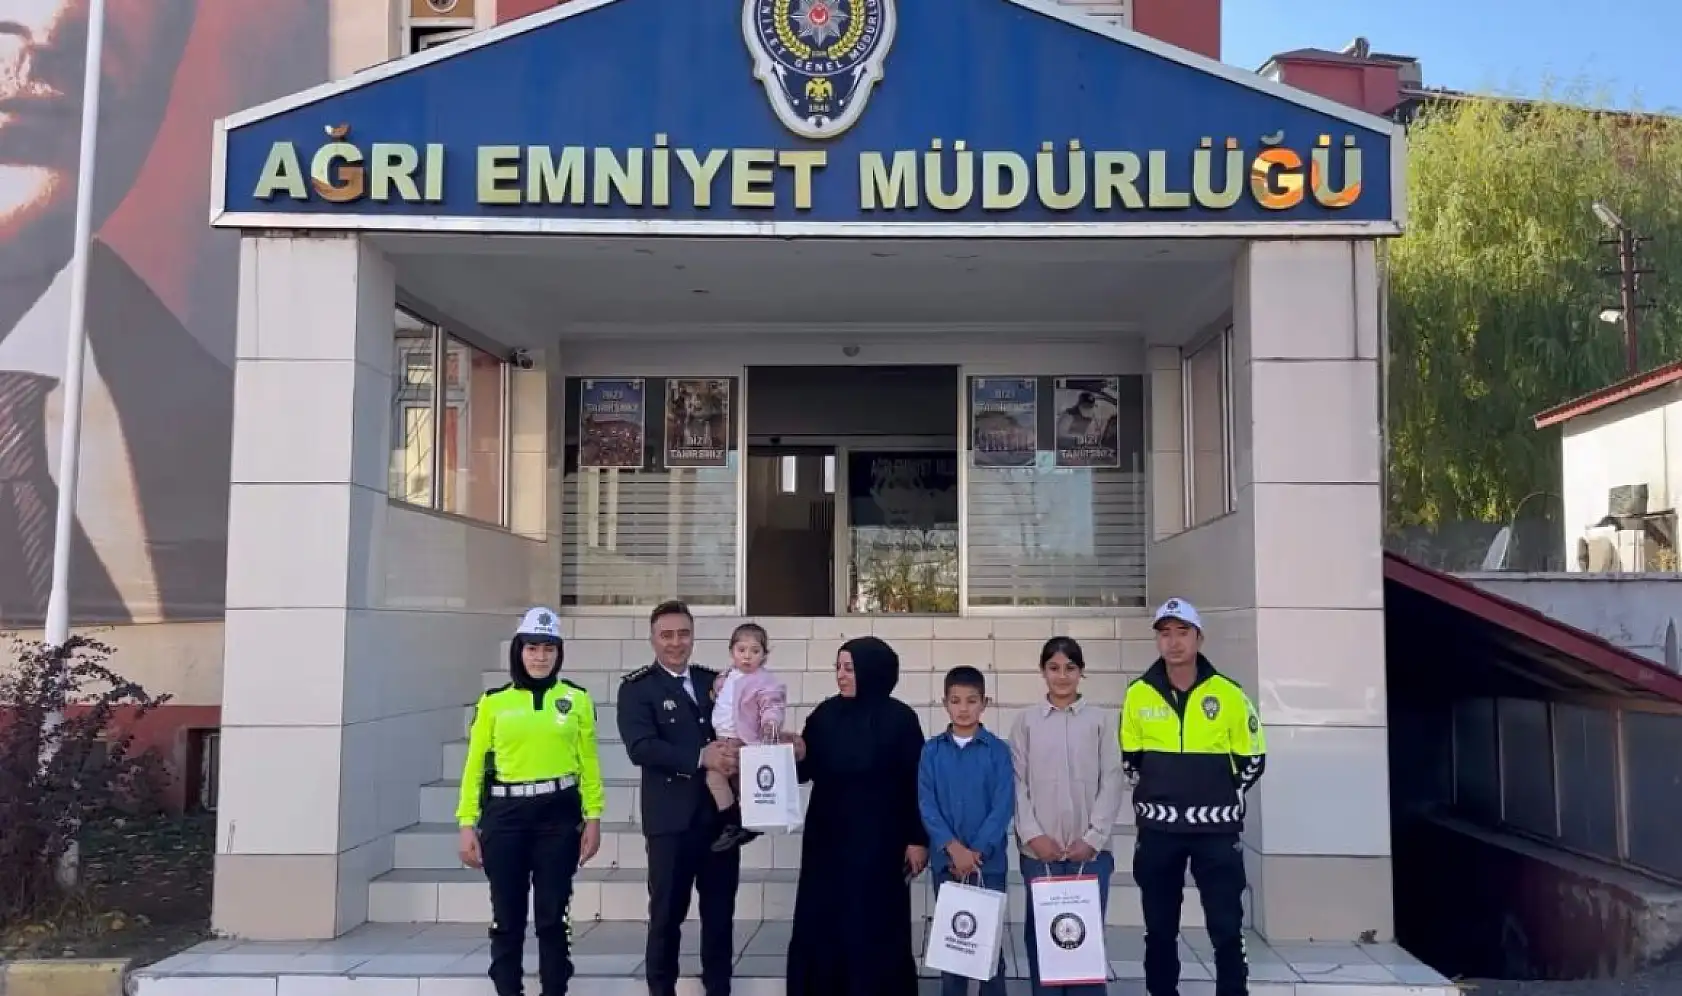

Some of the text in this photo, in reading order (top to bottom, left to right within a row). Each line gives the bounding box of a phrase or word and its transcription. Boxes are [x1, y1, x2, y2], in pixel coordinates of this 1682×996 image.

[254, 124, 1363, 210] AĞRI EMNİYET MÜDÜRLÜĞÜ
